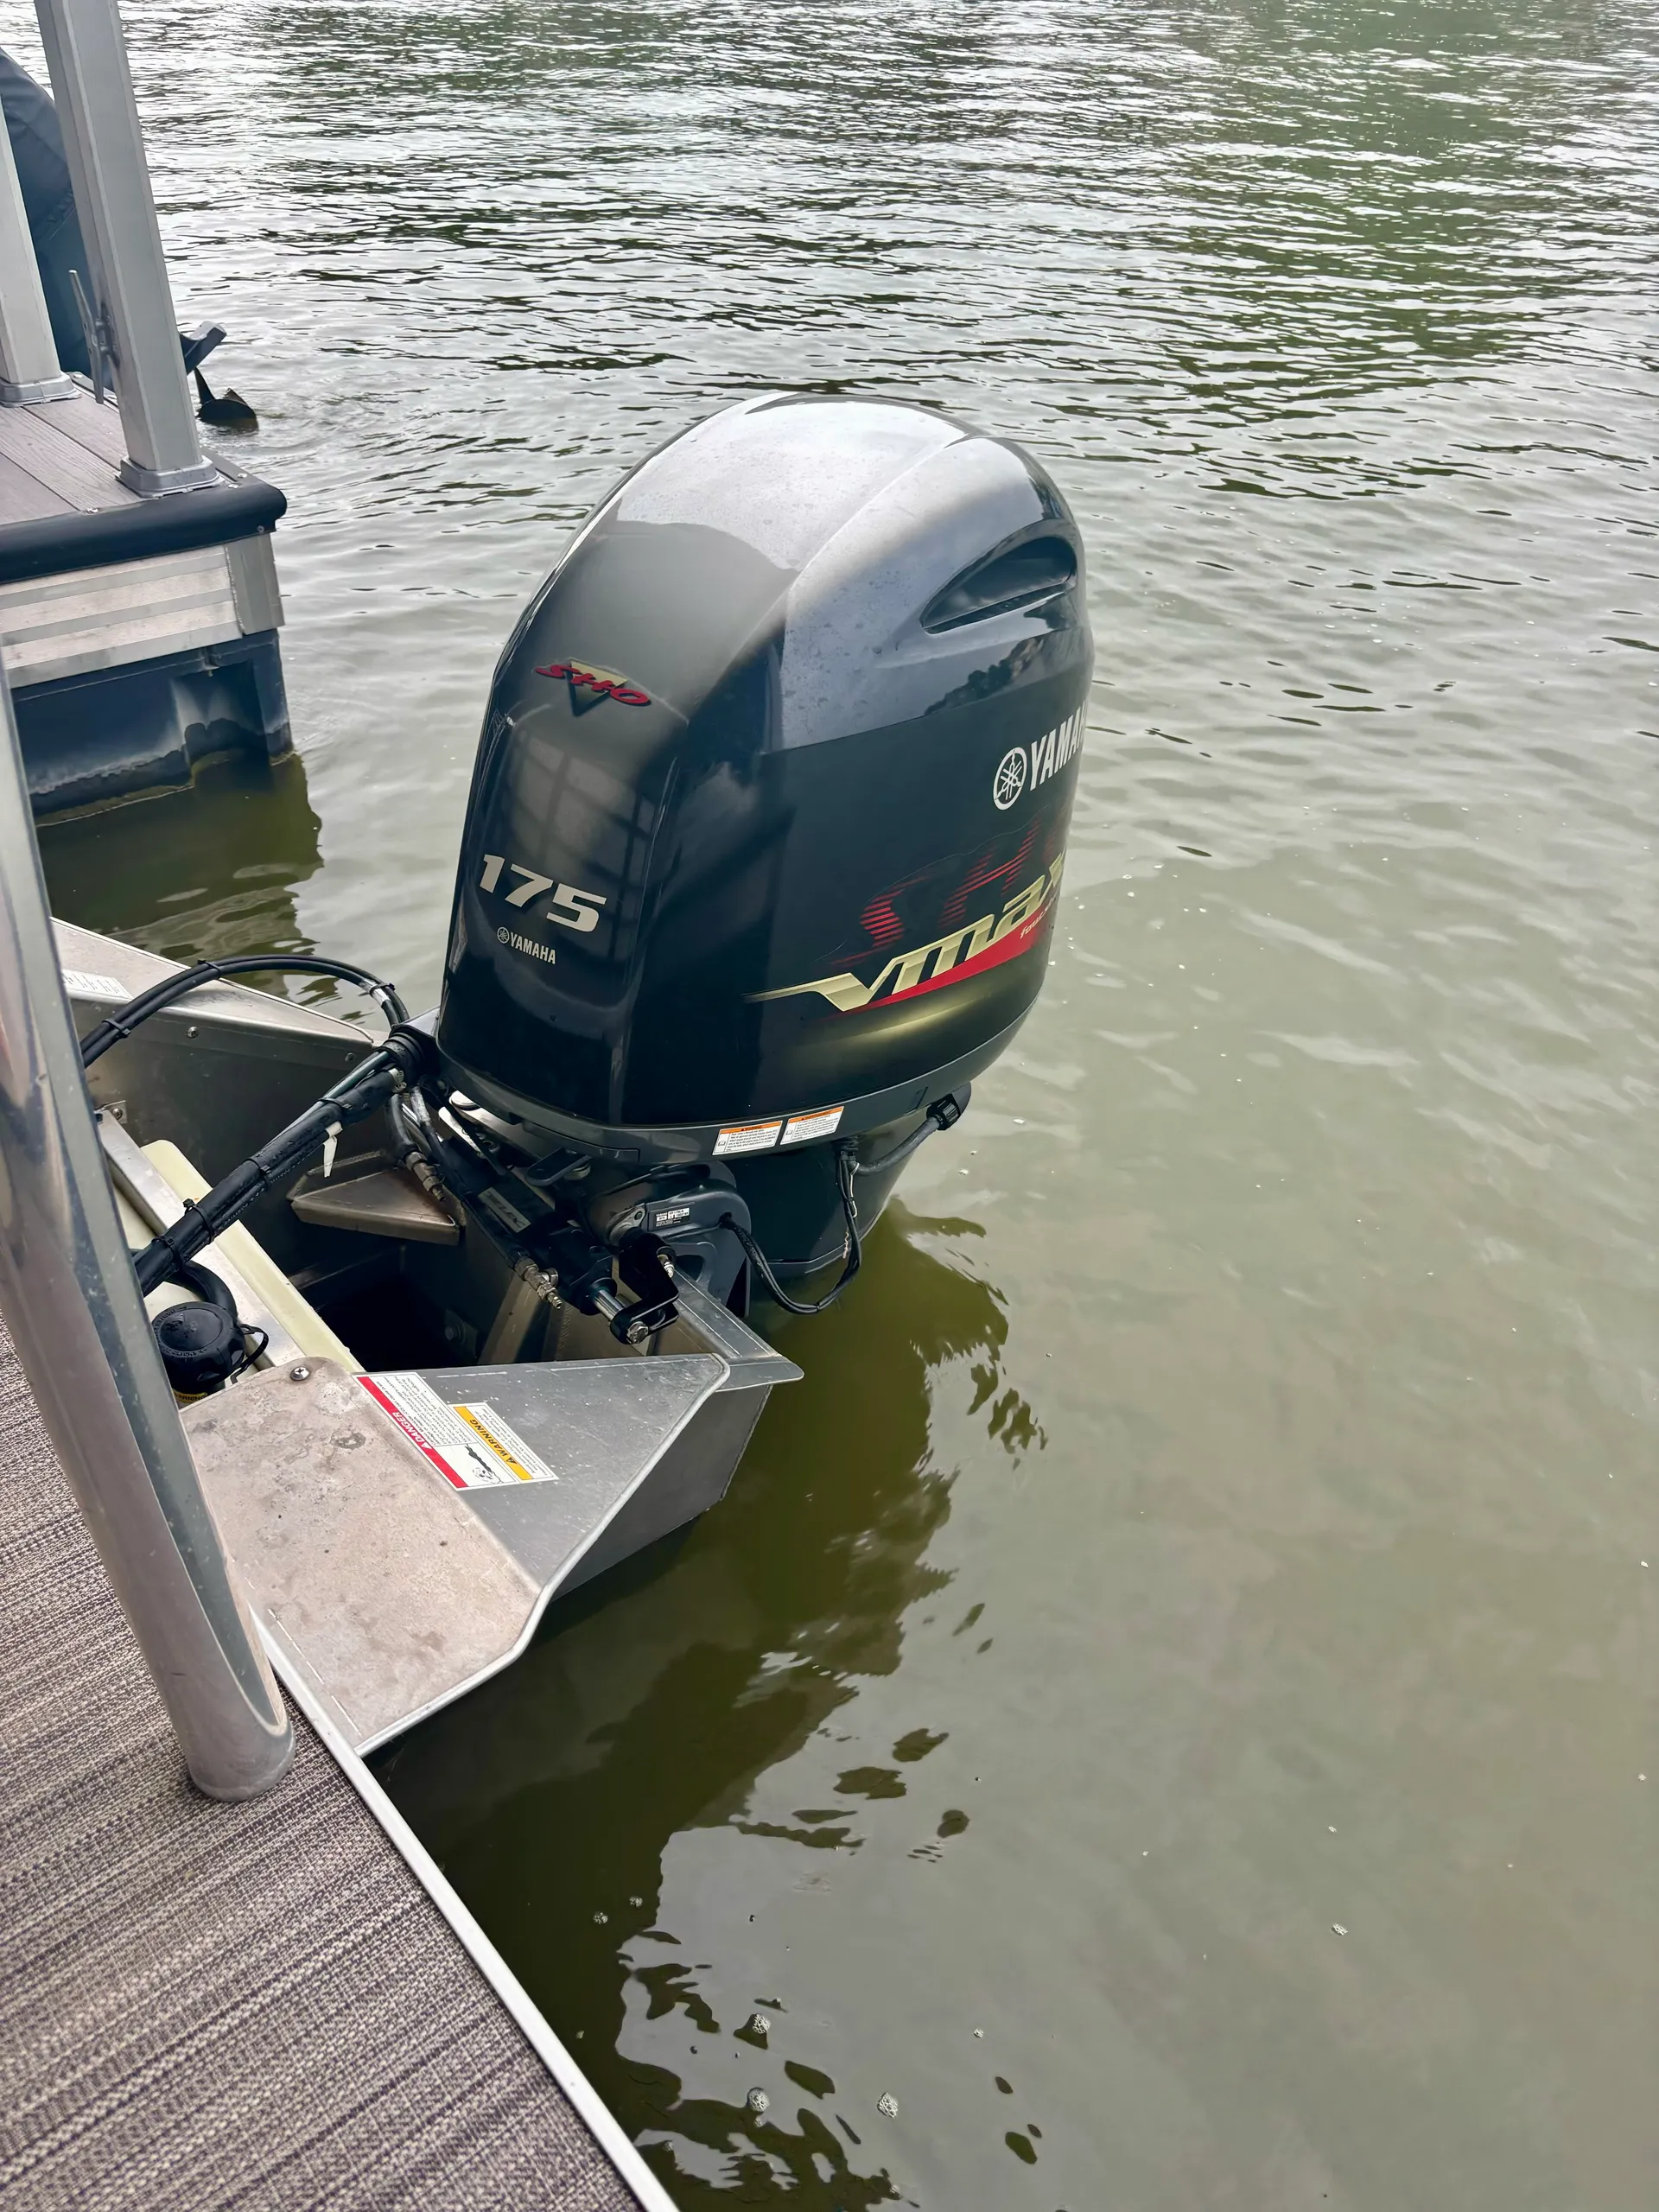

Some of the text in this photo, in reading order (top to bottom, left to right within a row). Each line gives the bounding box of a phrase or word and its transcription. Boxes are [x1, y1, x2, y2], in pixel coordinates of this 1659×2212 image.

[1029, 701, 1087, 791] YAMAH
[480, 854, 607, 932] 175
[510, 931, 556, 964] YAMAHA
[391, 1412, 425, 1442] DANGER
[469, 1419, 508, 1457] WARNING
